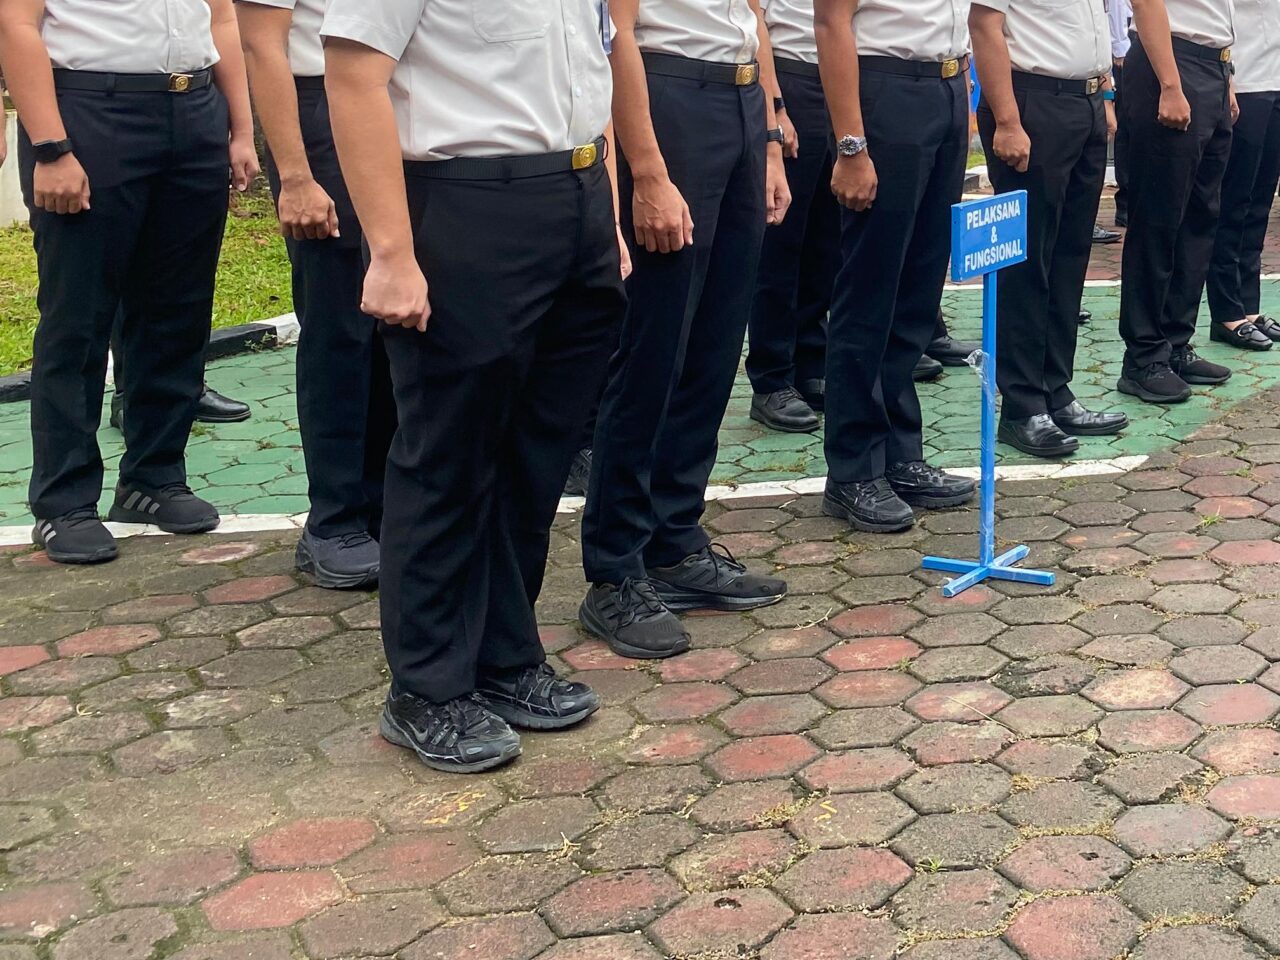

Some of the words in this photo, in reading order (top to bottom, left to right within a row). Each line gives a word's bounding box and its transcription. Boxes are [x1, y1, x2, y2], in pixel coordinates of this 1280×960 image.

[966, 199, 1021, 230] PELAKSANA
[990, 225, 998, 244] &
[964, 239, 1023, 273] FUNGSIONAL
